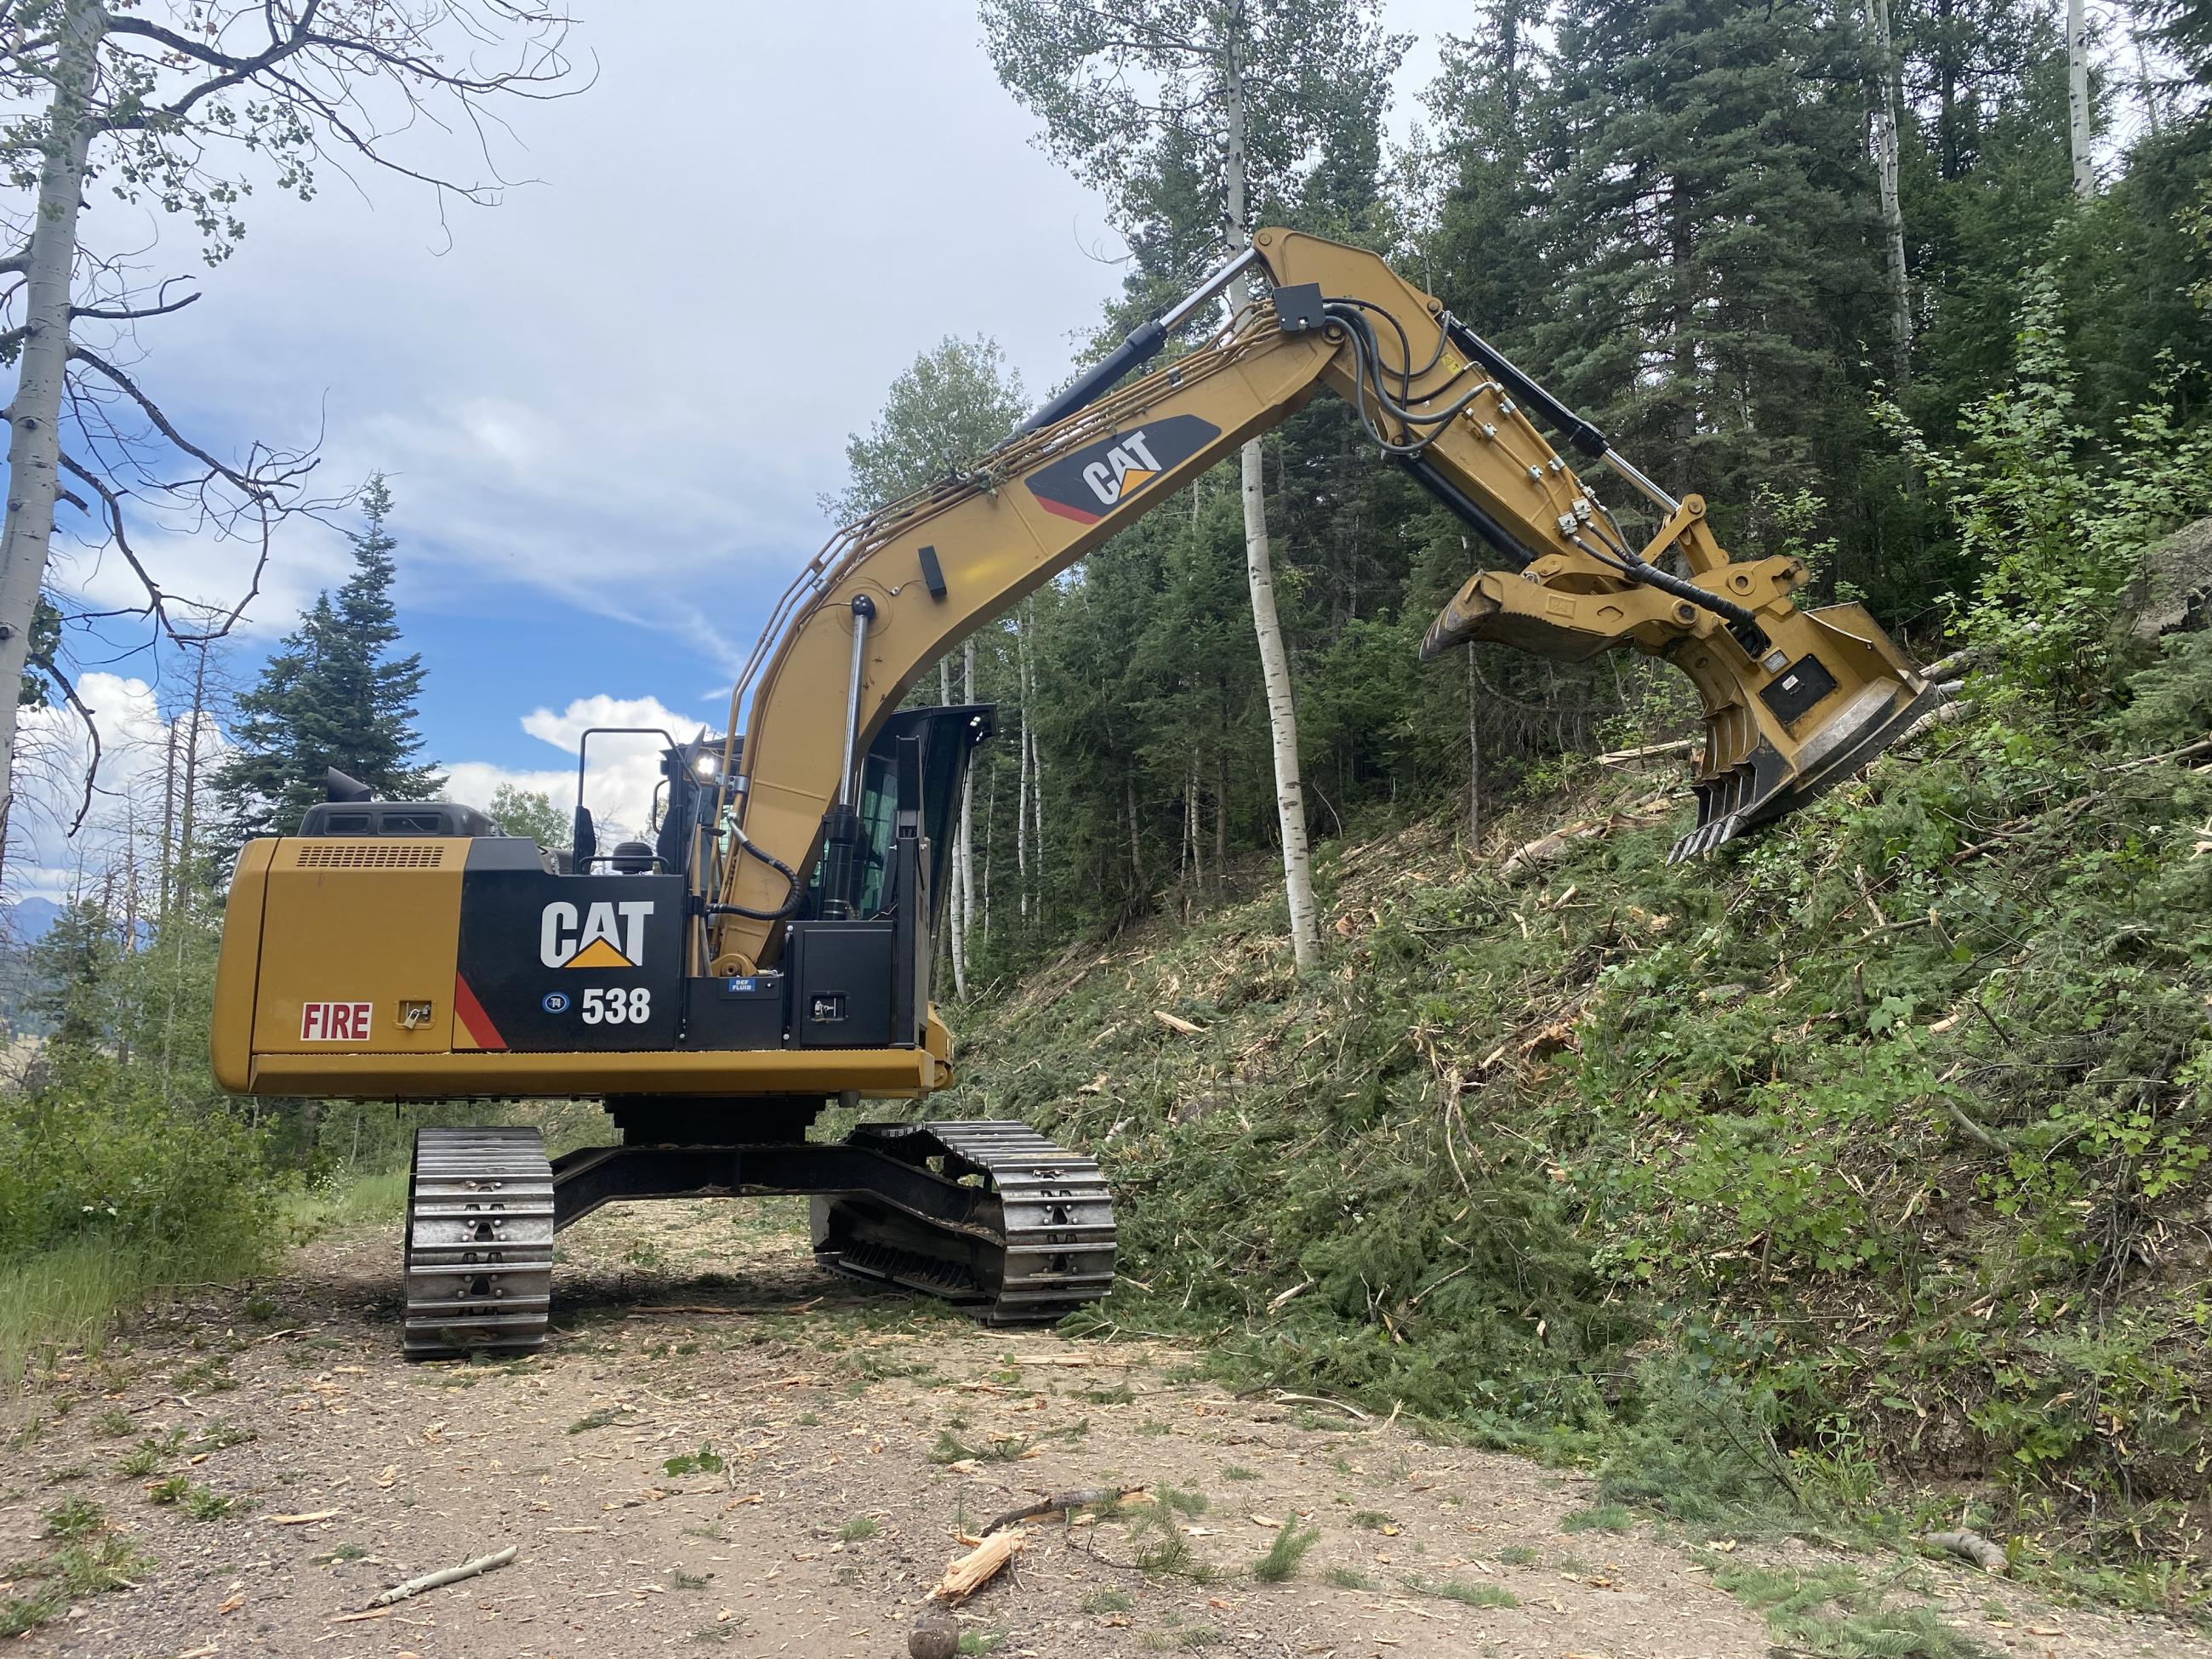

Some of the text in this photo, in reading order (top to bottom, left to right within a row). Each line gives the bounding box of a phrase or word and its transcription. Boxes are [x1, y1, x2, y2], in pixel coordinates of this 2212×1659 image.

[1082, 430, 1162, 505] CAT
[540, 901, 654, 968] CAT
[303, 1004, 369, 1039] FIRE
[582, 987, 651, 1024] 538
